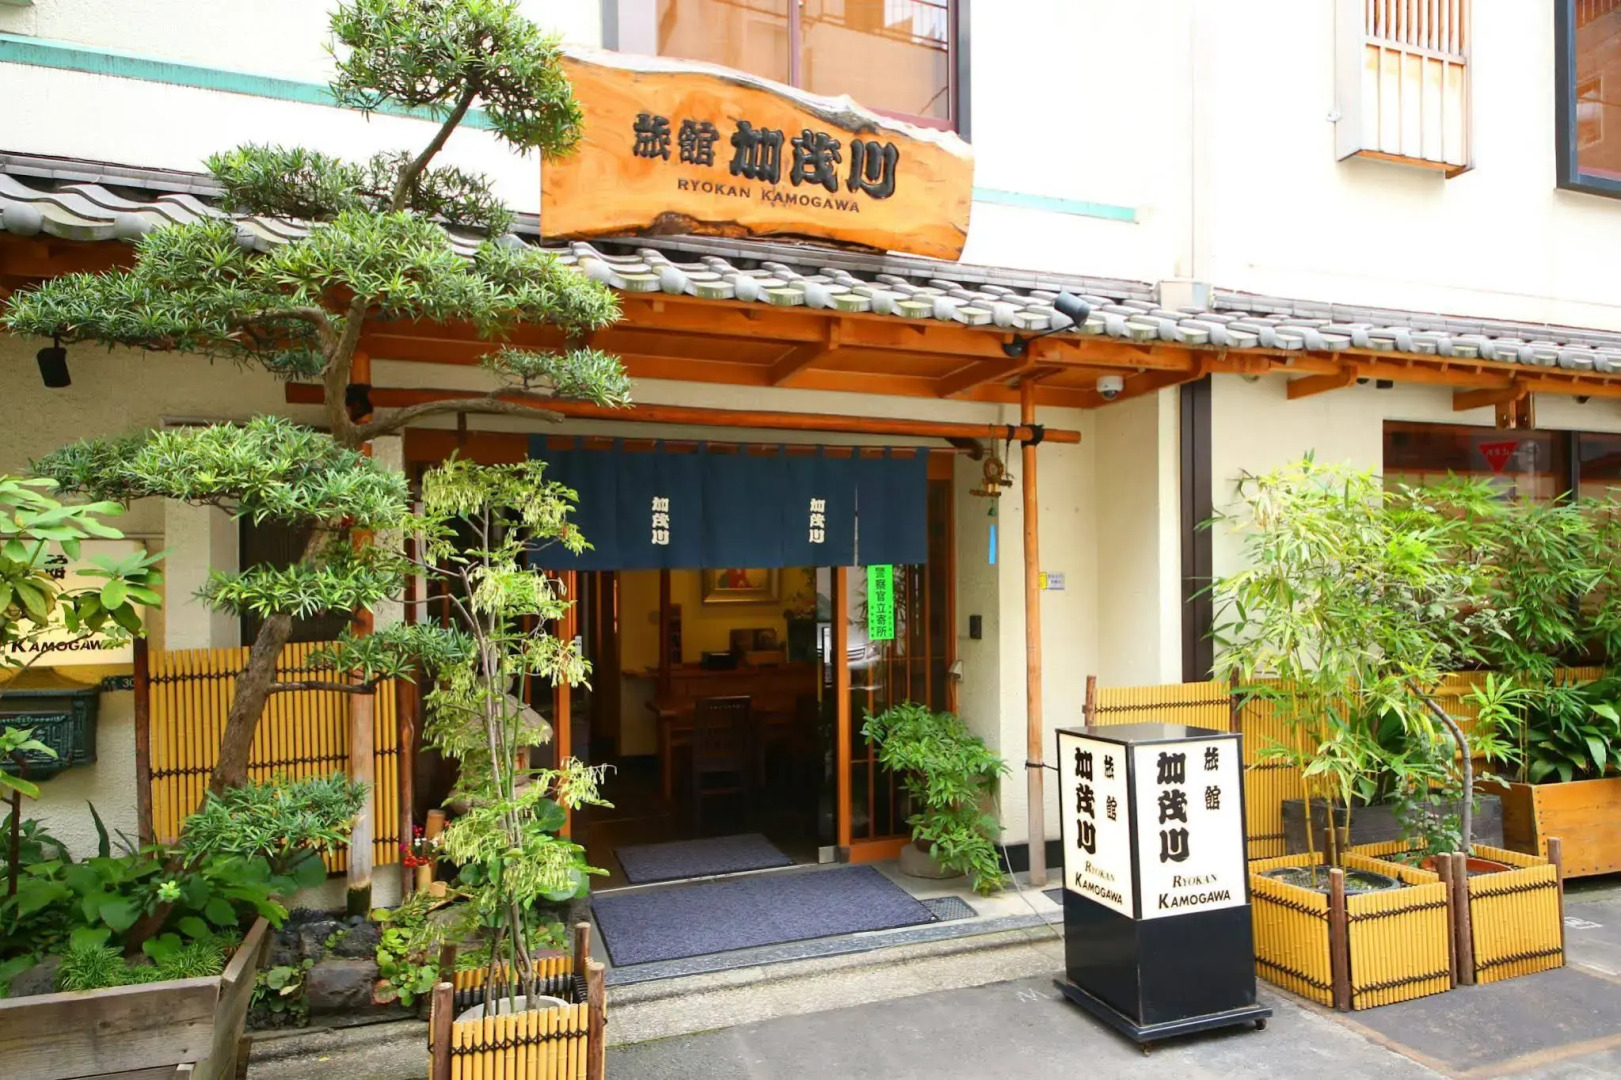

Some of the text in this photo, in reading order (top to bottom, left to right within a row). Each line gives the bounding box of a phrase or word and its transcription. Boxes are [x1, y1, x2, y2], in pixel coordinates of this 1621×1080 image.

[633, 113, 899, 199] 旅館 加茂川
[677, 178, 860, 213] RYOKAN KAMOGAWA
[651, 496, 670, 545] 加茂川
[808, 498, 826, 544] 加茂川
[11, 639, 101, 653] KAMOGAW
[1074, 747, 1097, 855] 加茂川
[1157, 752, 1189, 863] 加茂川
[1075, 871, 1123, 906] KAMOGAWA
[1158, 889, 1231, 910] KAMOGAWA
[1172, 873, 1219, 889] RYOKAN
